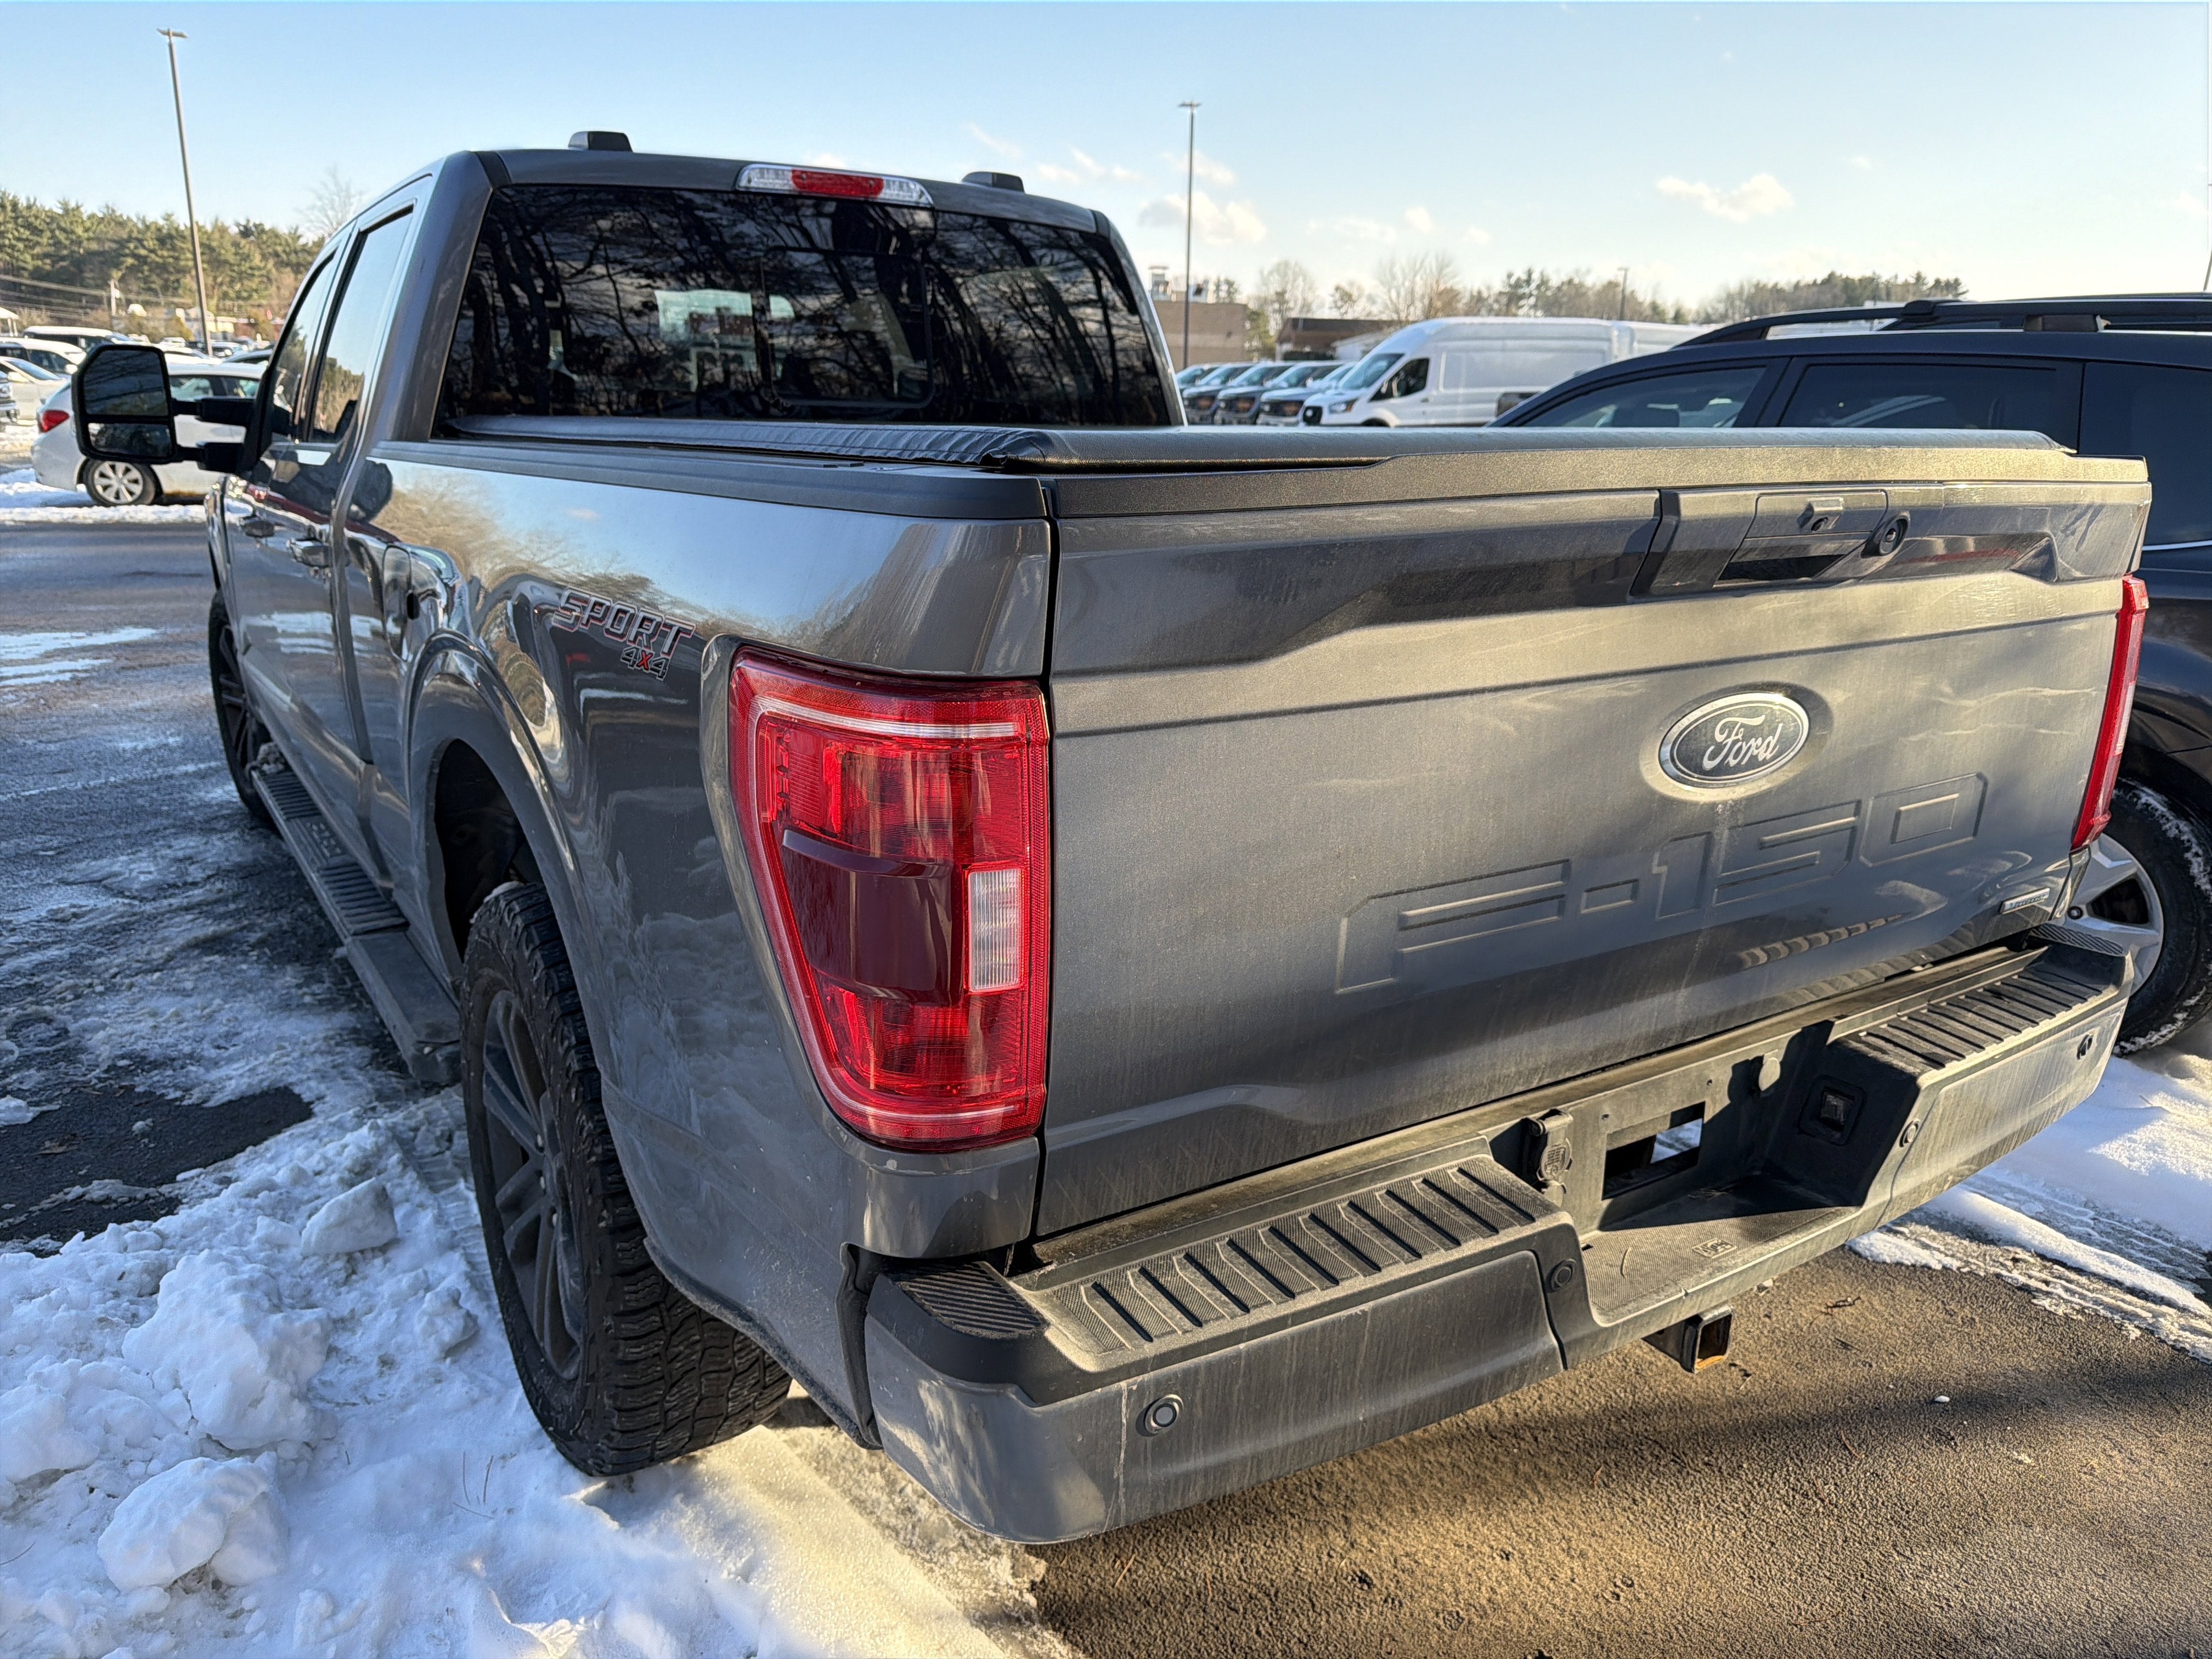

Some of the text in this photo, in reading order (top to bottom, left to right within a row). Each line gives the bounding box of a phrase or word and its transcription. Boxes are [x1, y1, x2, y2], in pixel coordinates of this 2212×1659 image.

[552, 586, 696, 658] SPORT
[1703, 714, 1784, 770] Ford
[1335, 772, 1988, 994] F-150
